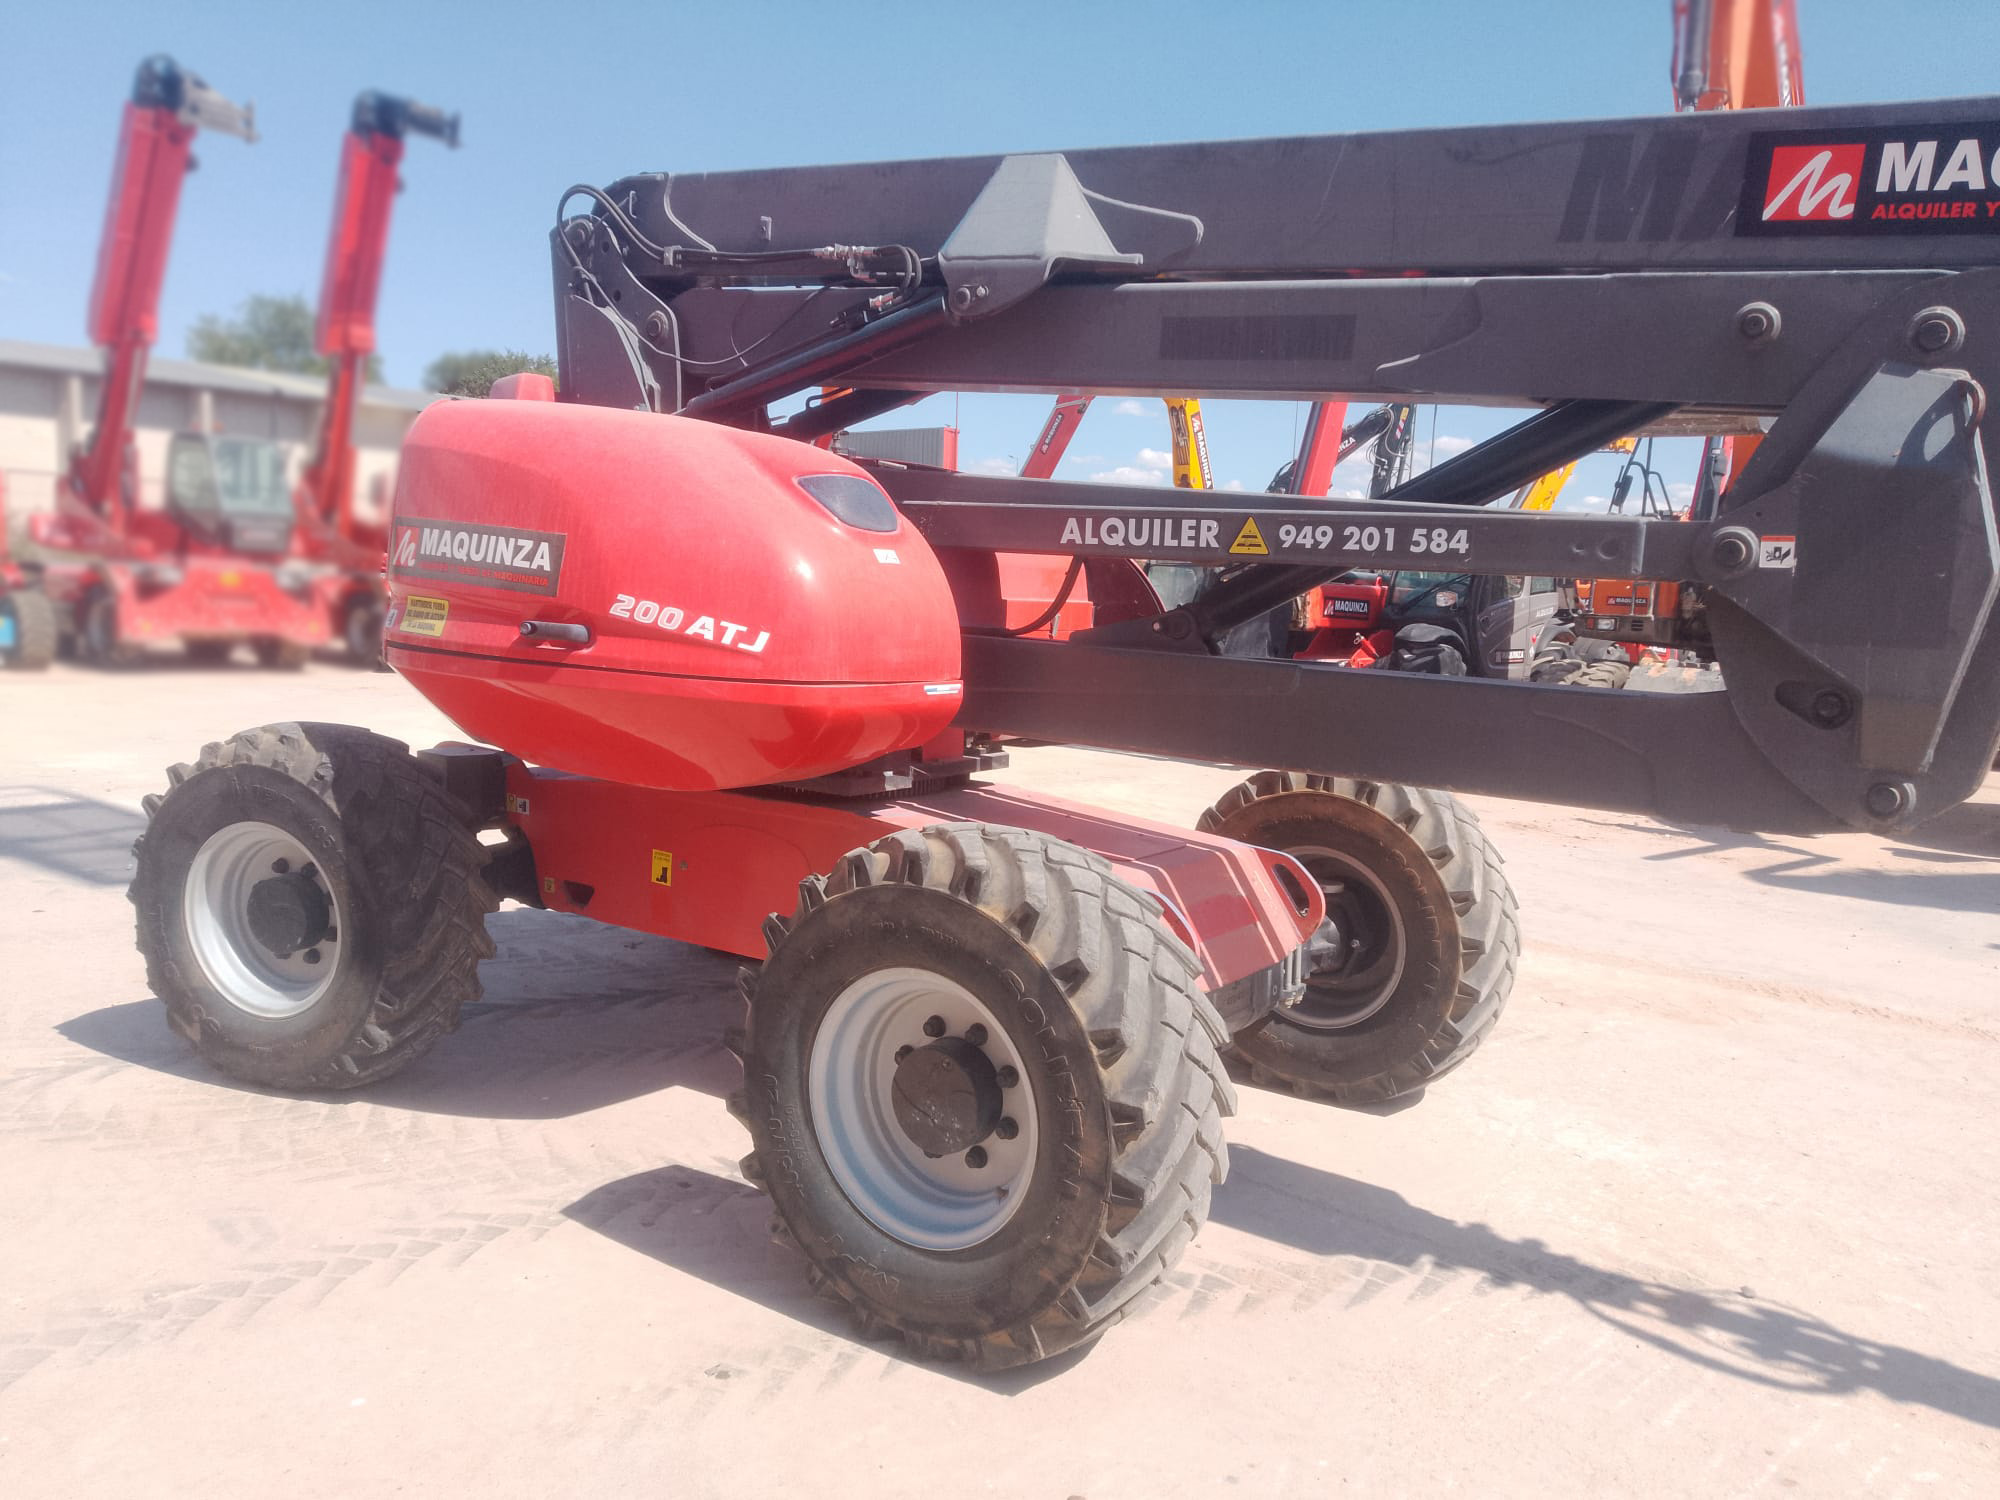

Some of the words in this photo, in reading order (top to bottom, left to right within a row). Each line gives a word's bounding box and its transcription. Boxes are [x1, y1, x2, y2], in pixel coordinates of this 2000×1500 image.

[1876, 139, 2000, 192] MA
[1871, 202, 1977, 220] ALQUILER
[1985, 201, 2000, 218] Y
[1196, 431, 1212, 489] MAQUINZA
[420, 527, 551, 572] MAQUINZA
[1060, 517, 1220, 548] ALQUILER
[1278, 524, 1334, 549] 949
[1342, 526, 1395, 551] 201
[1409, 528, 1470, 554] 584
[609, 594, 684, 630] 200
[685, 615, 770, 653] ATJ
[1334, 600, 1368, 614] MAQUINZA
